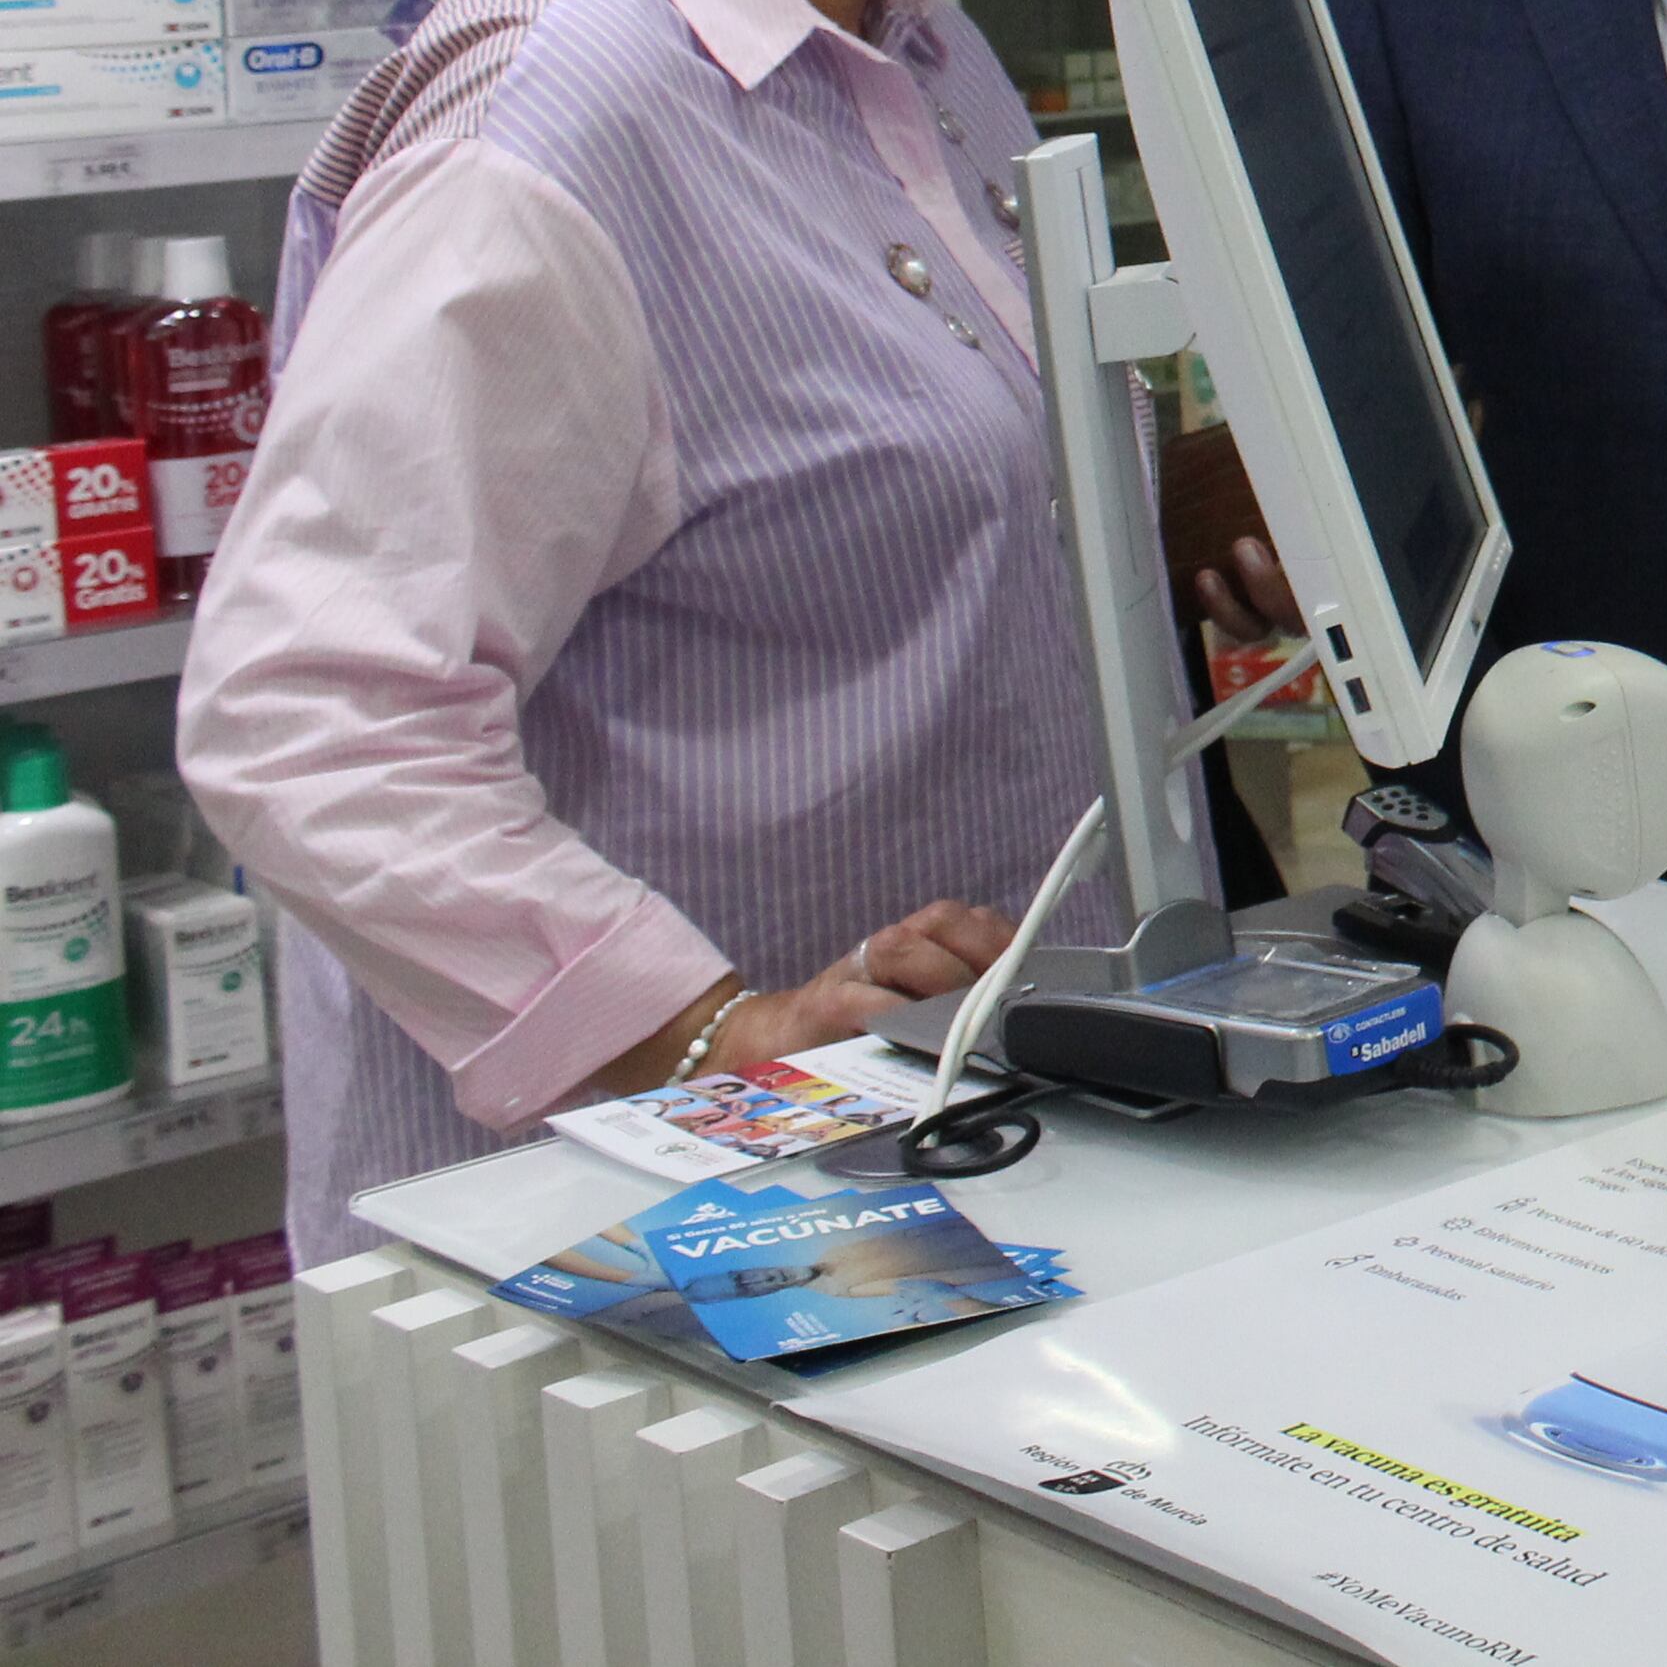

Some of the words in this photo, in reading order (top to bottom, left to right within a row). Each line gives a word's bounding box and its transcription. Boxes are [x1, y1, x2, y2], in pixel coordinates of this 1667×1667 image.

[1361, 1022, 1427, 1062] Sabadell
[669, 1197, 947, 1259] VACÚNATE
[1524, 1205, 1595, 1237] Personas
[1595, 1227, 1619, 1241] de
[1420, 1243, 1490, 1273] Personal
[1488, 1265, 1557, 1294] sanitario
[1472, 1224, 1548, 1255] Enfermos
[1545, 1249, 1615, 1276] crónicos
[1361, 1262, 1467, 1304] Embarazadas
[1019, 1442, 1082, 1474] Región
[1280, 1421, 1325, 1445] La
[1320, 1437, 1428, 1484] vacuna
[1422, 1475, 1461, 1499] es
[1449, 1488, 1583, 1545] gratuita
[1120, 1485, 1150, 1502] de
[1145, 1496, 1210, 1528] Murcia
[1180, 1414, 1316, 1474] Infórmate
[1309, 1467, 1352, 1494] en
[1347, 1481, 1387, 1506] tu
[1380, 1492, 1479, 1541] centro
[1473, 1527, 1521, 1555] de
[1512, 1545, 1610, 1591] salud
[1312, 1569, 1539, 1667] #YoMeVacunoRM
